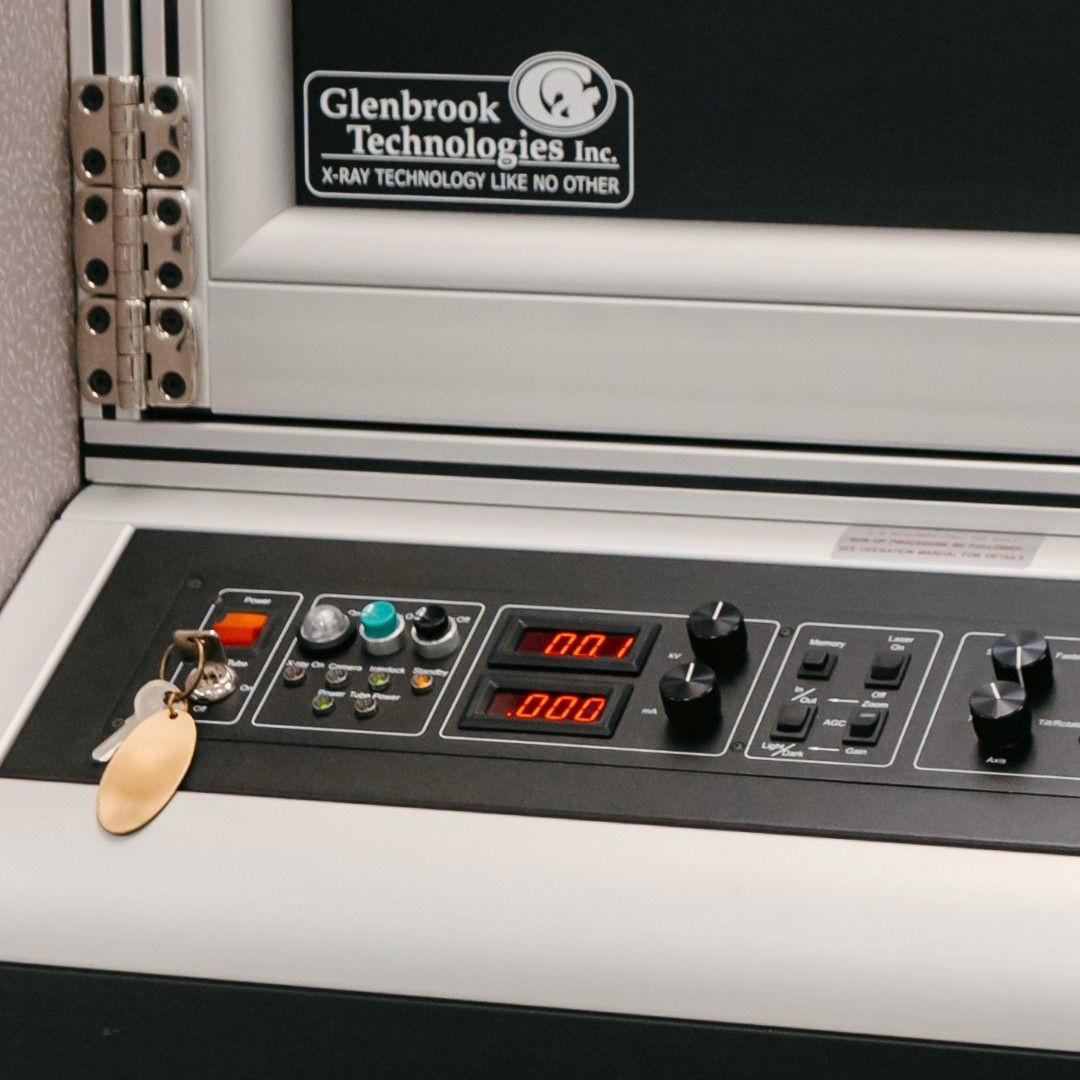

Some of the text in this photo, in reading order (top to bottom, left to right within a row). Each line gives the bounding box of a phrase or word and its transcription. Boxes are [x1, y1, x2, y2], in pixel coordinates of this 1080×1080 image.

[320, 88, 501, 124] Glenbrook
[346, 124, 618, 169] Technologies Inc.
[322, 167, 620, 195] X-RAY TECHNOLOGY LIKE NO OTHER
[808, 638, 847, 649] Memory
[861, 700, 889, 708] Zoom
[822, 719, 847, 727] AGC
